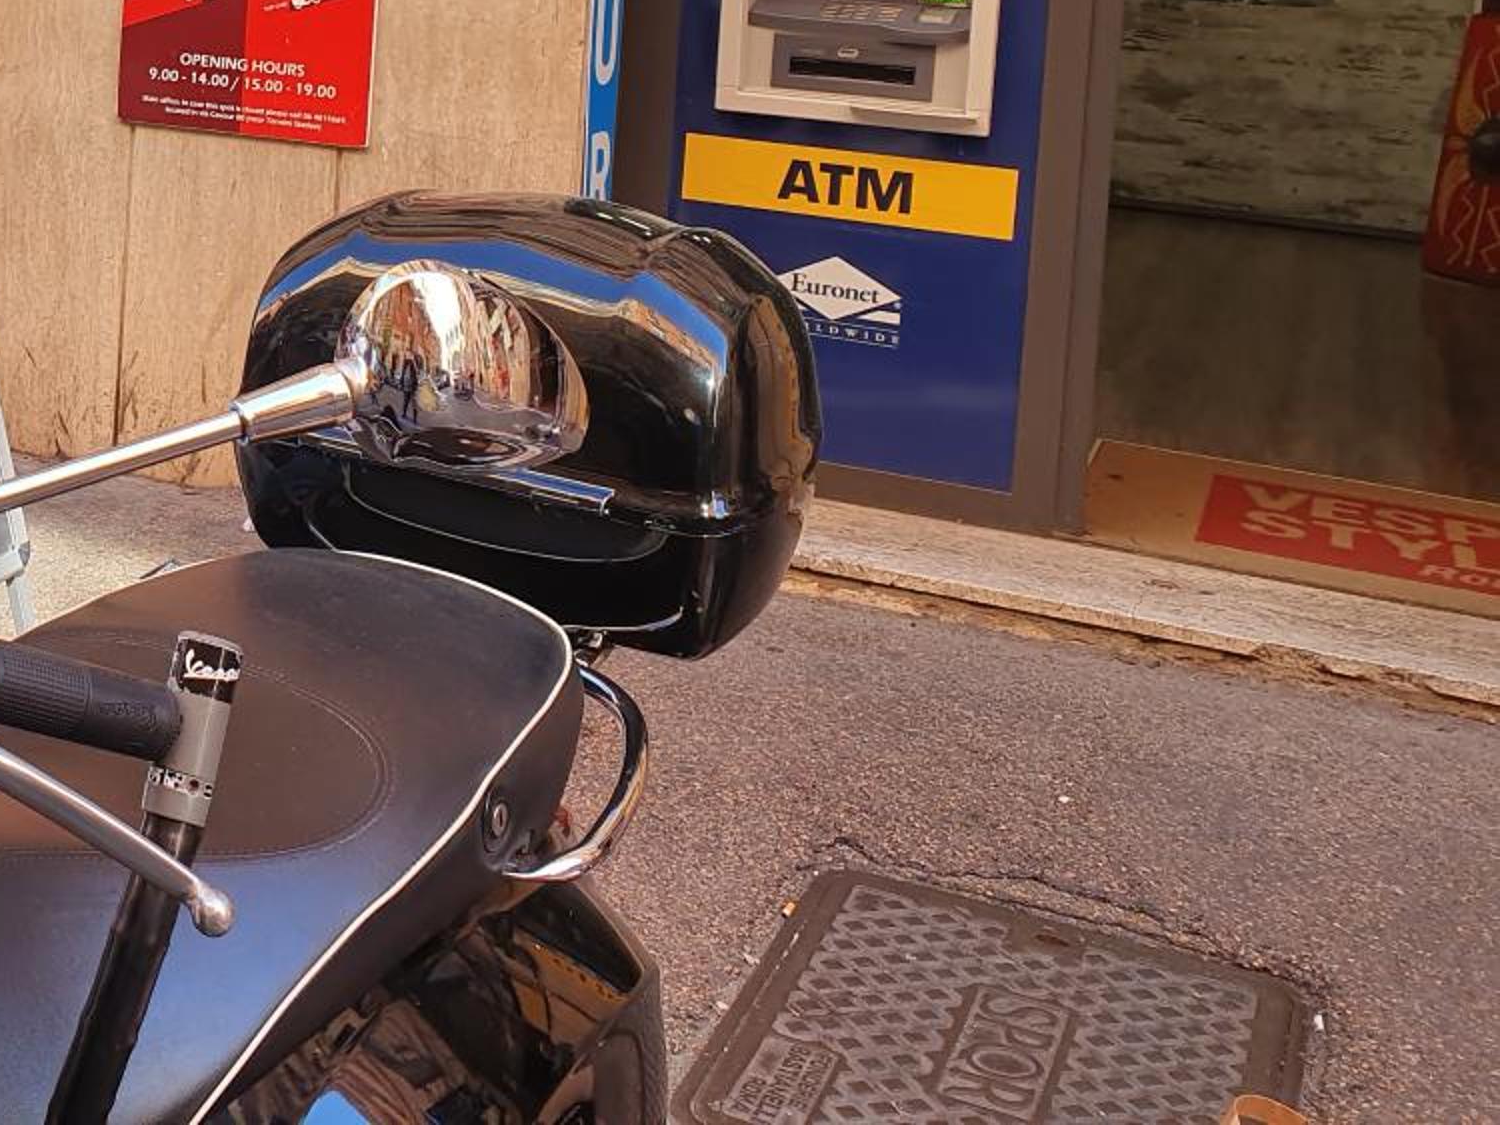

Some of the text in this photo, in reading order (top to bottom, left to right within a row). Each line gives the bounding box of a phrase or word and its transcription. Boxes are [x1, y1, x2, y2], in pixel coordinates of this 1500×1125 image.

[179, 52, 306, 77] OPENING HOURS
[148, 67, 180, 82] 9.00
[191, 72, 229, 87] 14.00
[243, 79, 283, 94] 15.00
[296, 82, 337, 99] 19.00
[777, 158, 915, 215] ATM
[790, 272, 880, 304] Euronet
[804, 321, 899, 345] LDWIDE
